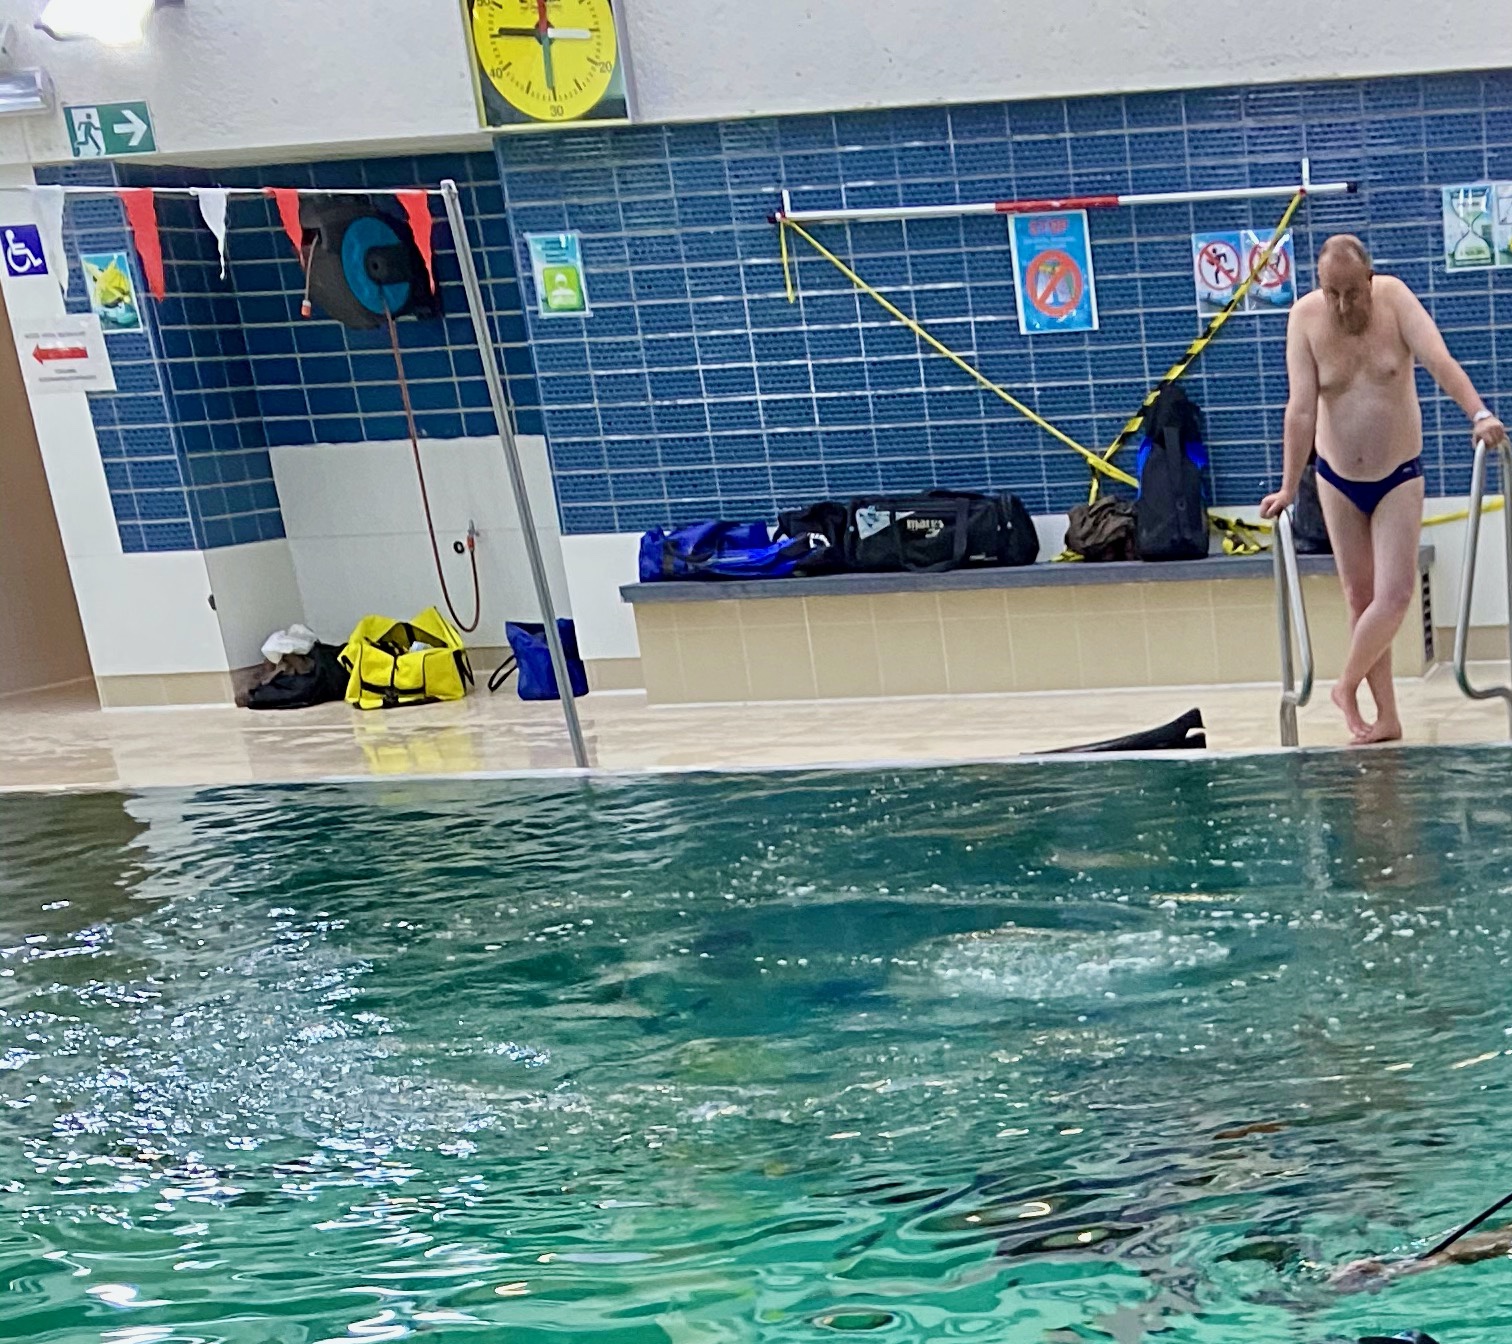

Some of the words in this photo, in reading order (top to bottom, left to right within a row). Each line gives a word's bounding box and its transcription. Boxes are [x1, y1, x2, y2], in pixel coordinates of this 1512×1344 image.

[490, 68, 503, 79] 40
[600, 62, 613, 74] 20
[550, 105, 564, 117] 30
